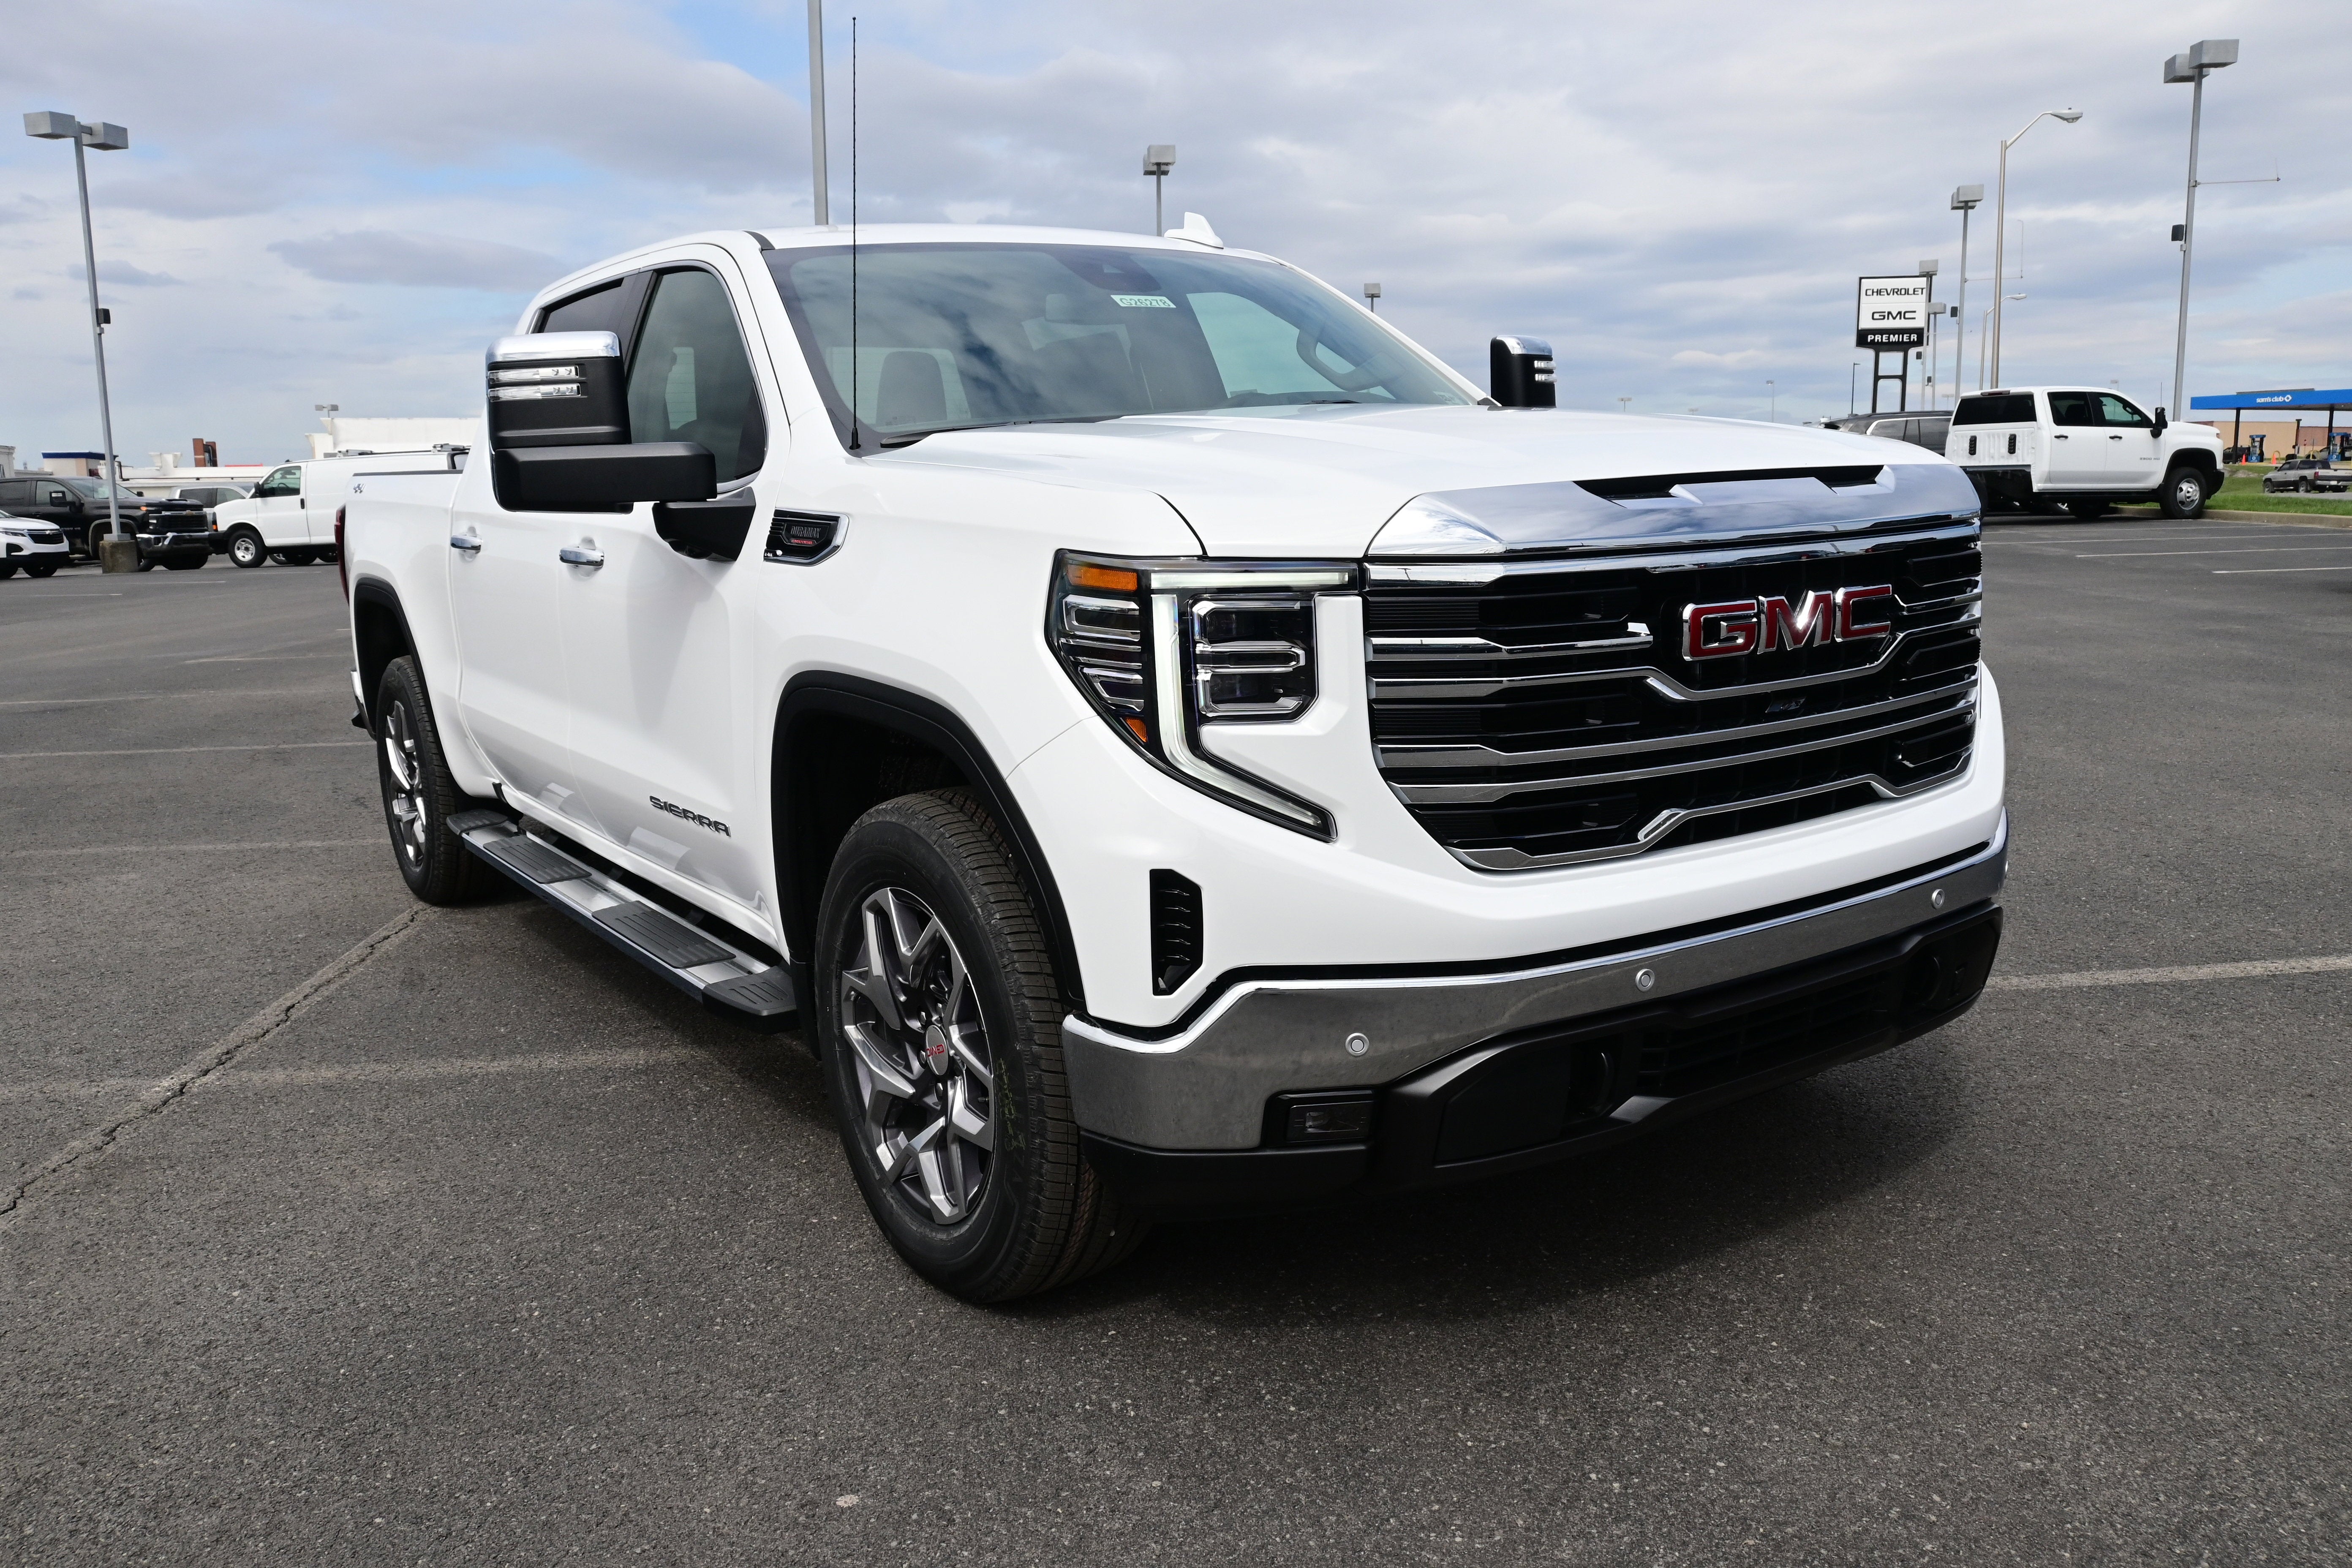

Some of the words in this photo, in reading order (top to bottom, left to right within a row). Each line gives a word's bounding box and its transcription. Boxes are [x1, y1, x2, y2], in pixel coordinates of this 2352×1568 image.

[1865, 287, 1926, 296] CHEVROLET
[1119, 298, 1171, 307] G26278
[1871, 310, 1916, 320] GMC
[1867, 334, 1917, 343] PREMIER
[790, 525, 822, 539] DURAMAX
[1682, 584, 1892, 662] GMC
[649, 795, 732, 838] SIERRA
[926, 1043, 945, 1057] GMC
